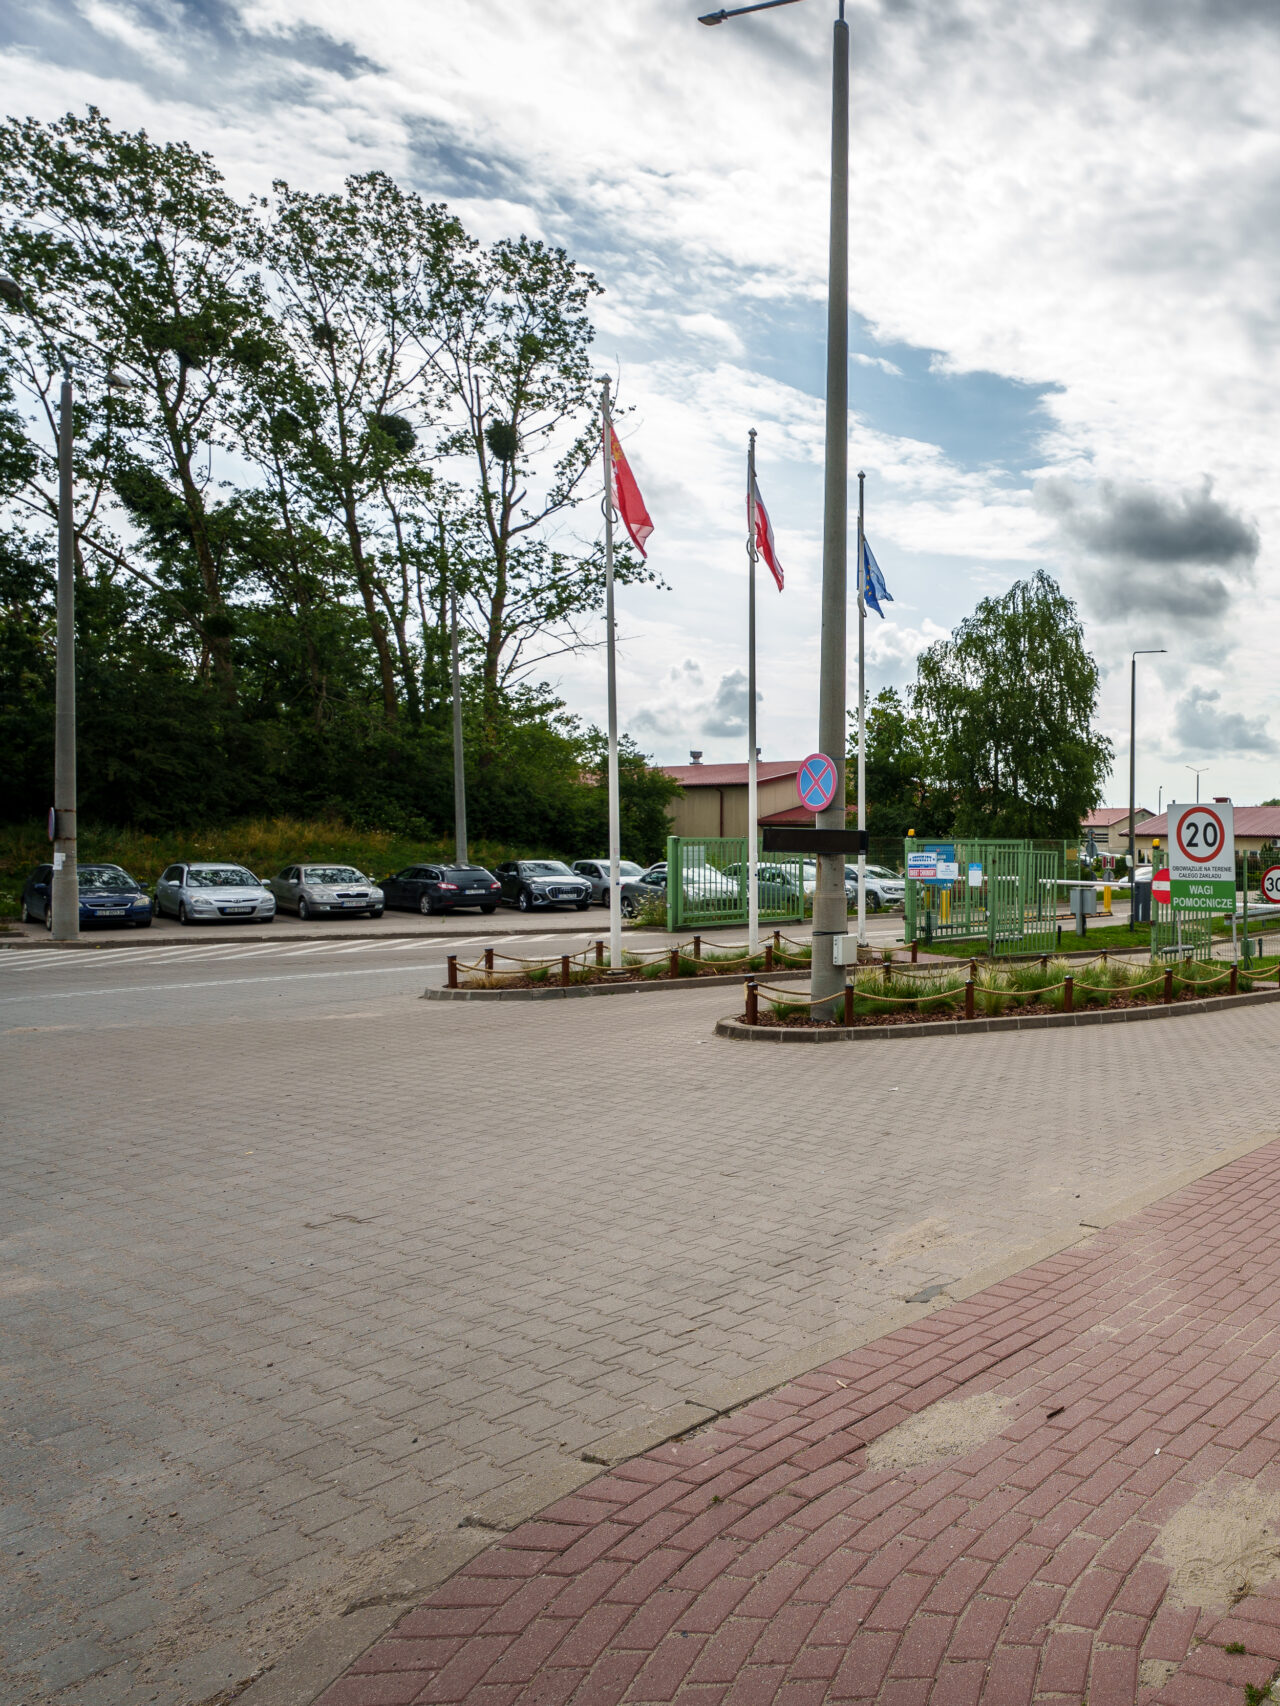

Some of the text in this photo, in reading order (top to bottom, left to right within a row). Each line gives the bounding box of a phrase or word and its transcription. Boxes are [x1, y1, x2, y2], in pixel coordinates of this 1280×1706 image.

[1186, 822, 1217, 847] 20
[1172, 865, 1203, 873] OBOWIĄZUJE
[1189, 884, 1214, 895] WAGI
[1173, 897, 1233, 909] POMOCNICZE
